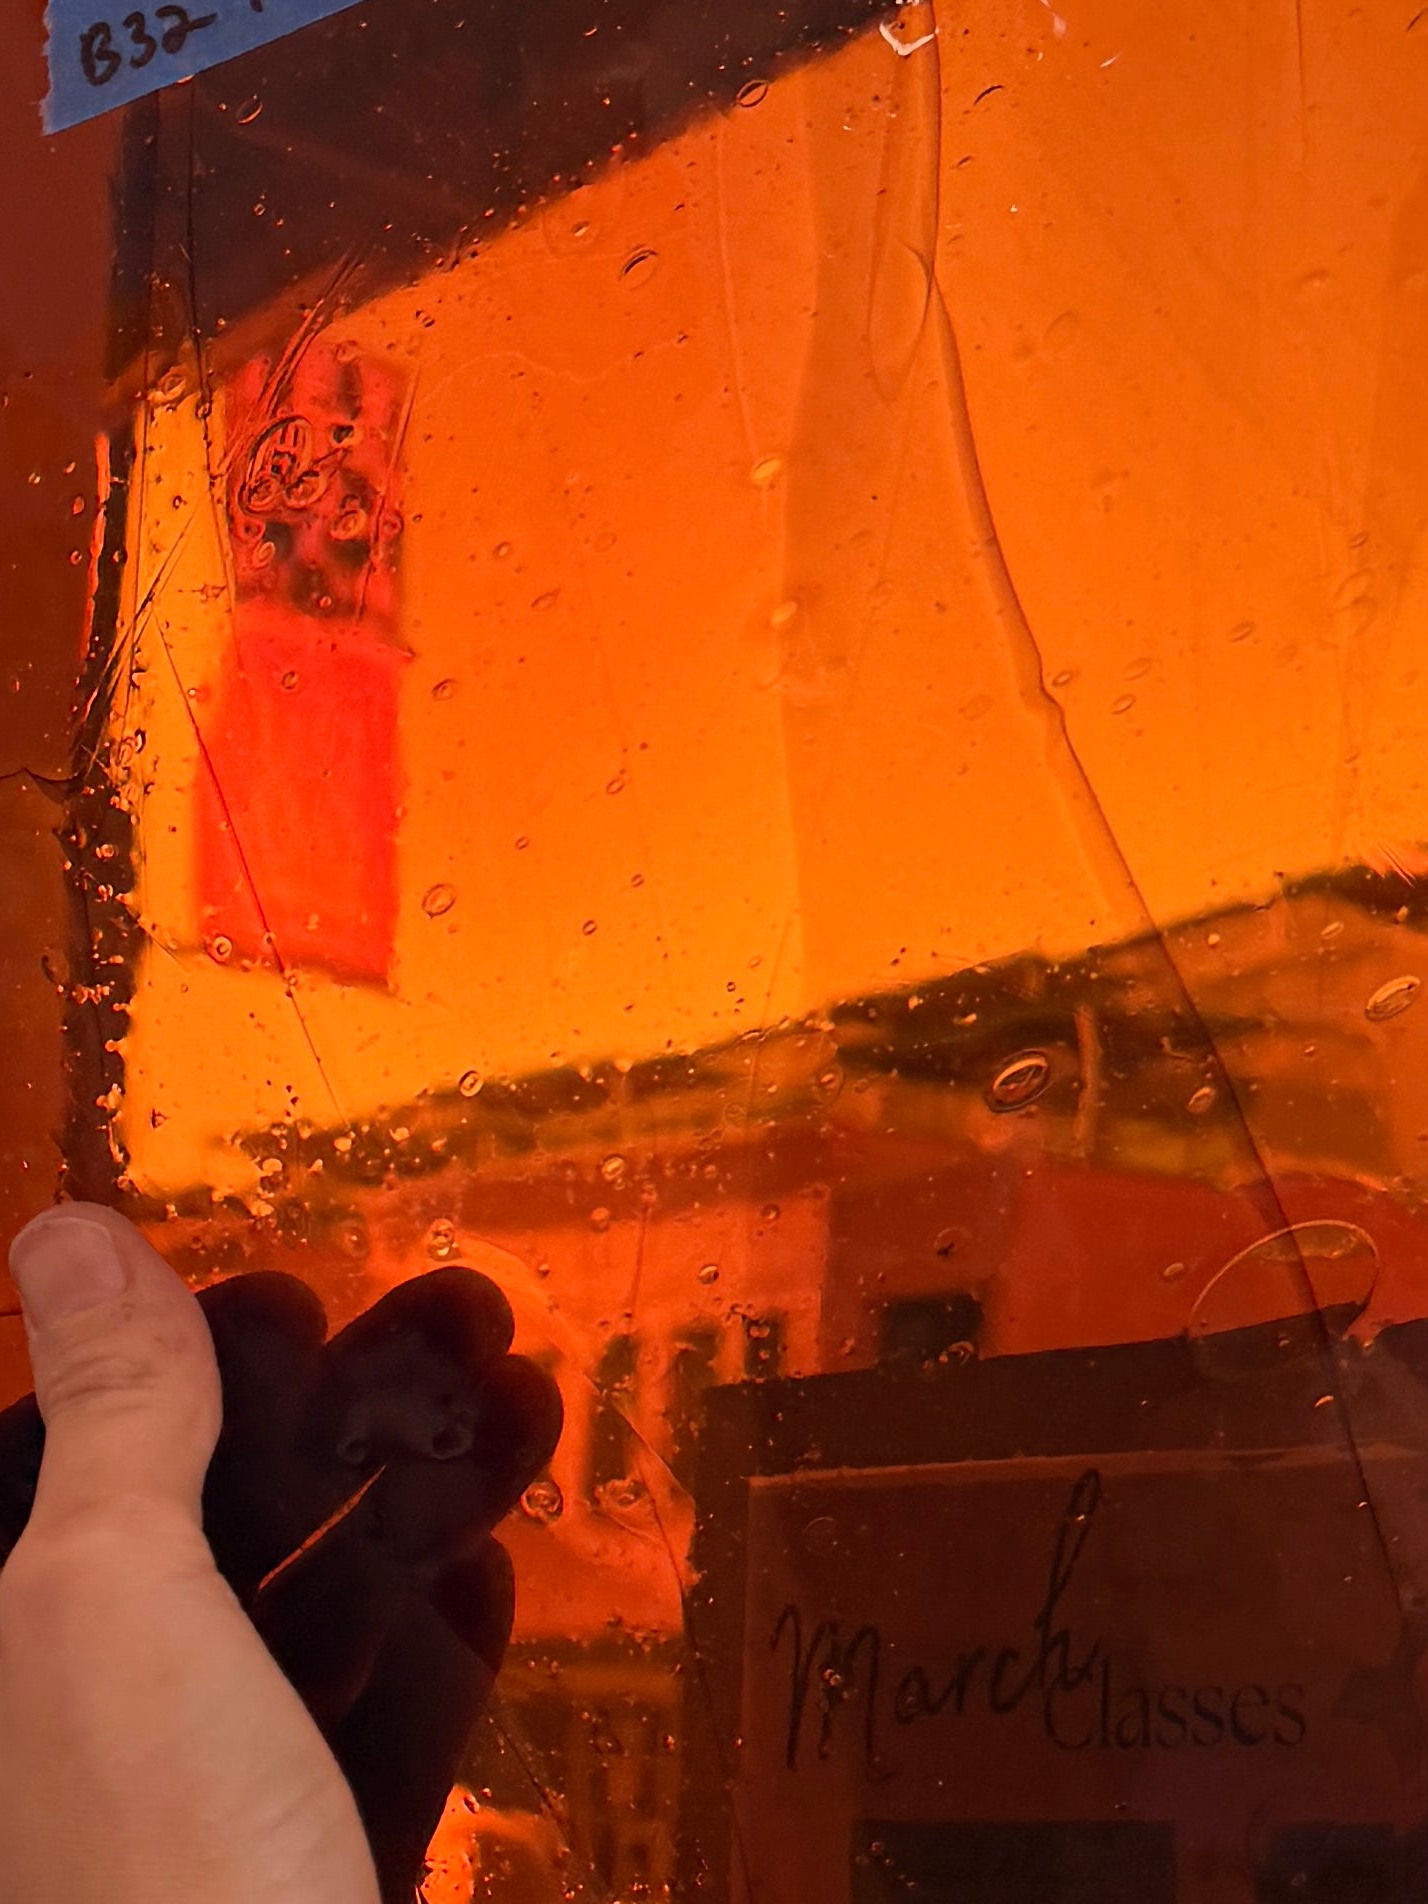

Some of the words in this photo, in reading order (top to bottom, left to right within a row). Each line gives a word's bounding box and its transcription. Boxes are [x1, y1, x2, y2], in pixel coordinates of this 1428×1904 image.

[79, 3, 218, 86] B32
[769, 1468, 1102, 1784] March
[1042, 1669, 1309, 1752] Classes
